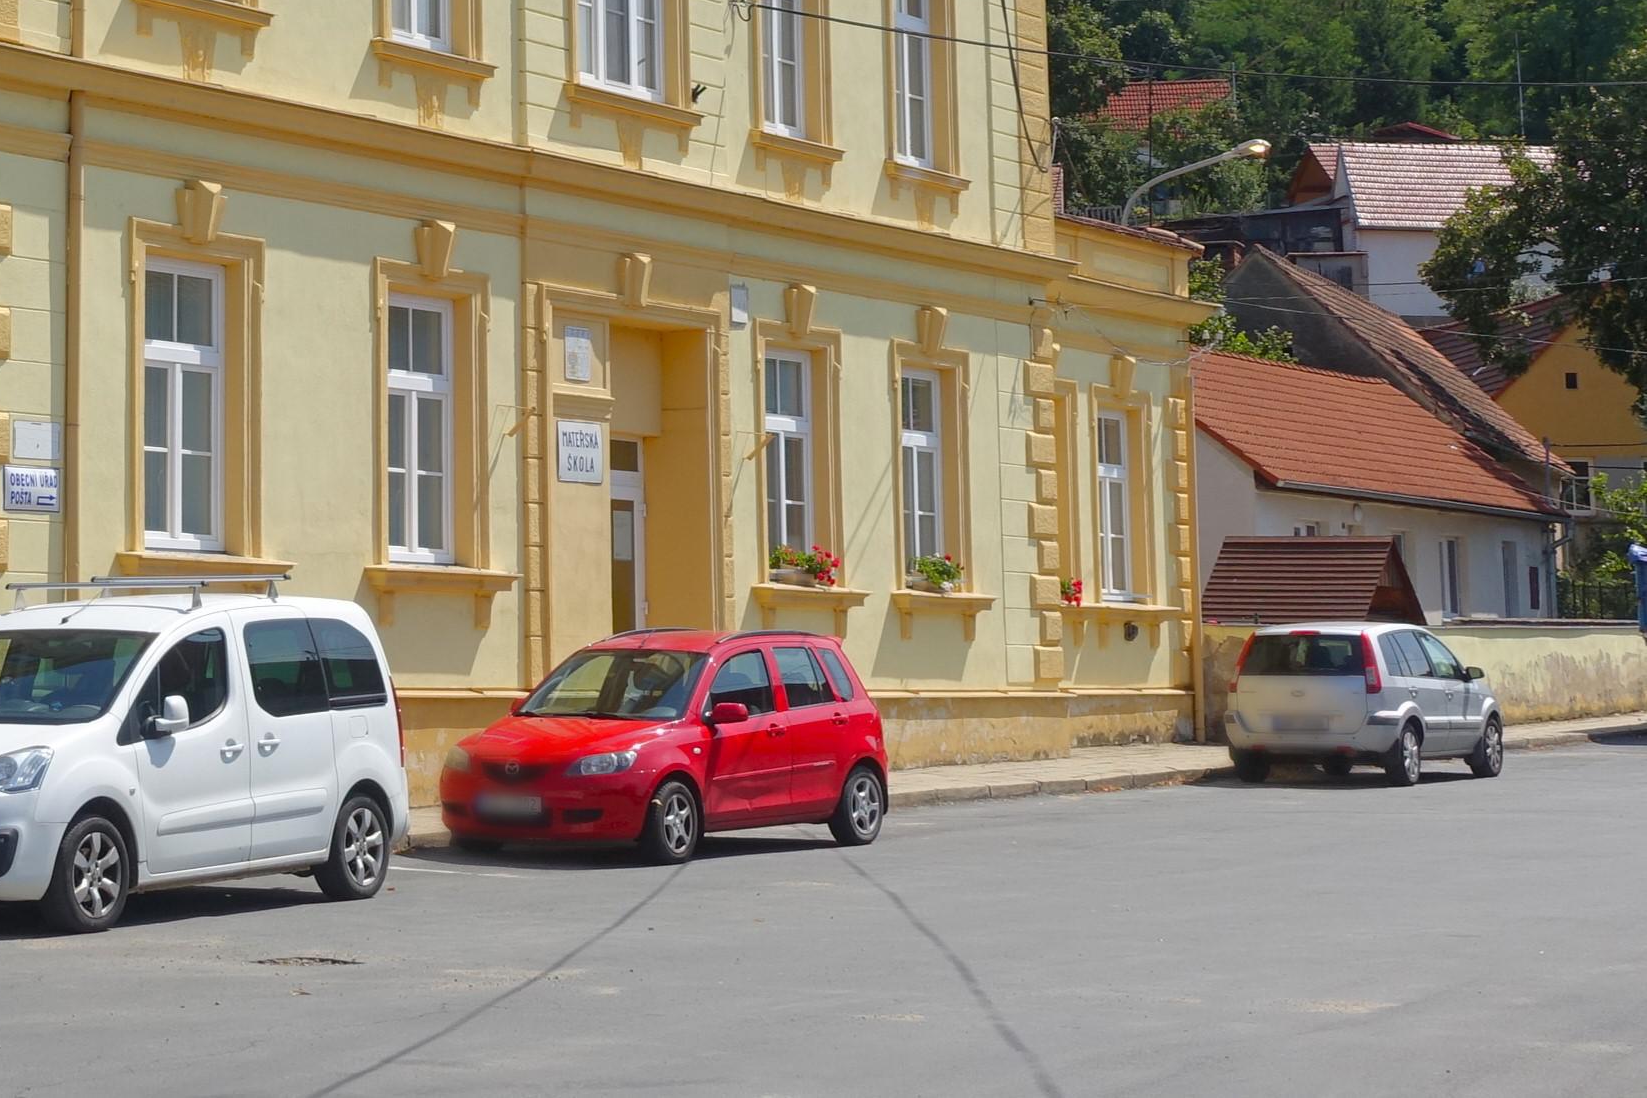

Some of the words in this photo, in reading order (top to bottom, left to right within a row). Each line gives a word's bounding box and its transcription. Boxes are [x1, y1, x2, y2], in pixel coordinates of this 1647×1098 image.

[562, 429, 599, 449] MATEŘSKÁ
[567, 453, 595, 473] ŠKOLA
[10, 472, 38, 487] OBECNÍ
[11, 488, 32, 505] POŠTA
